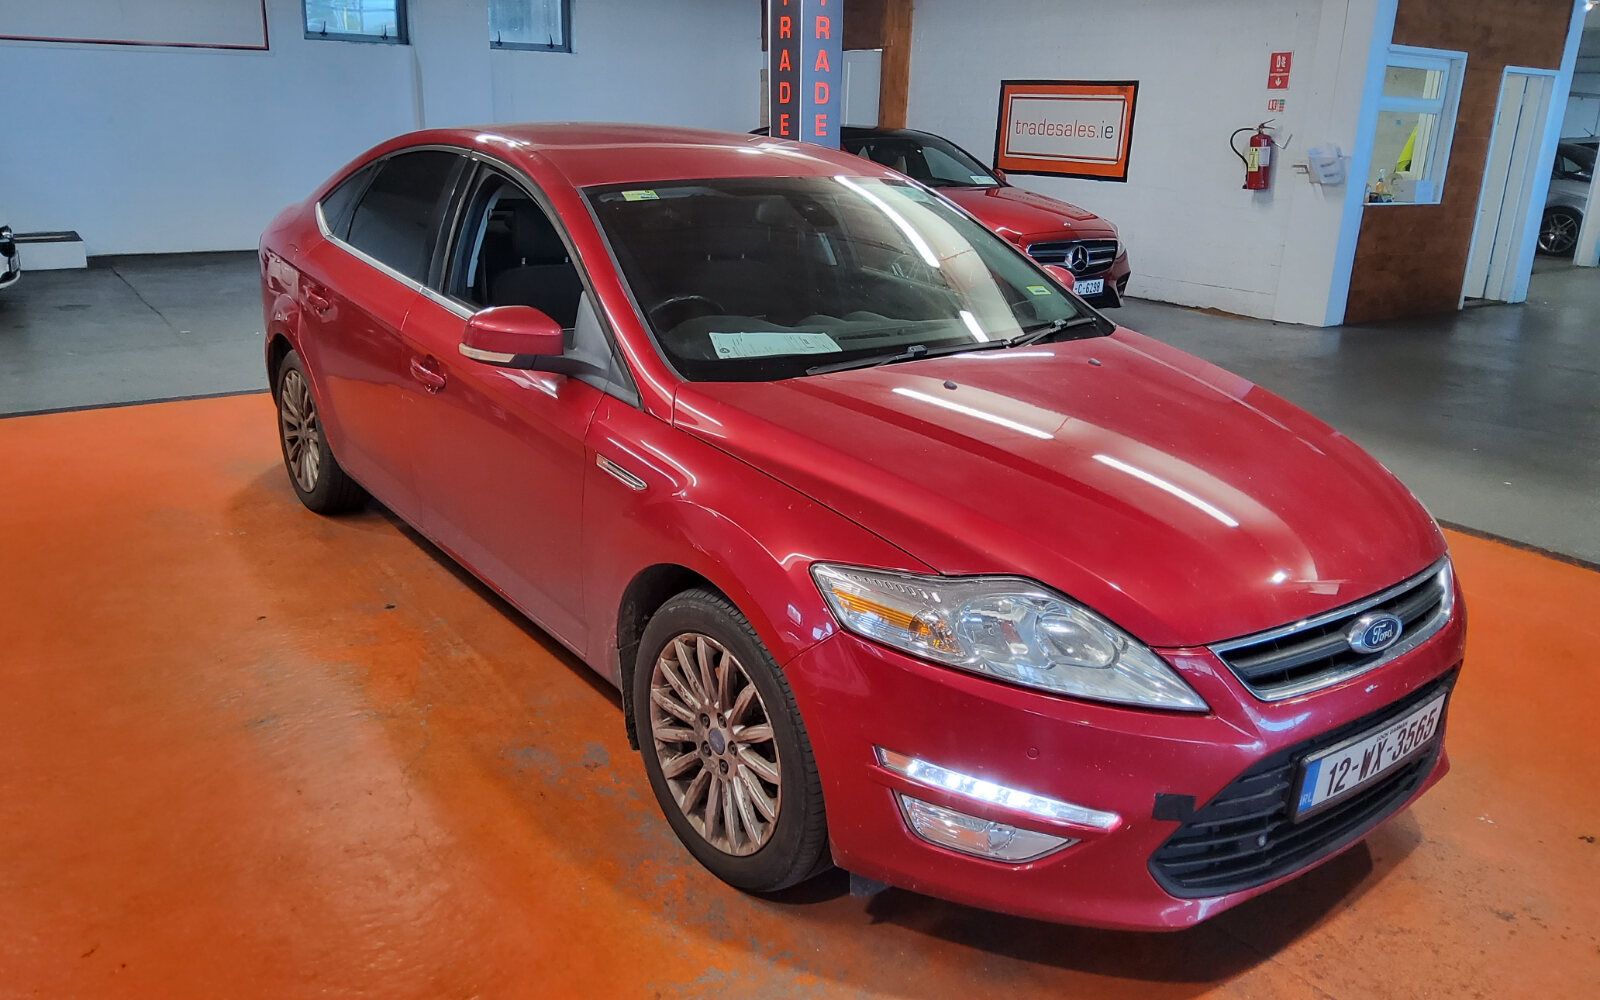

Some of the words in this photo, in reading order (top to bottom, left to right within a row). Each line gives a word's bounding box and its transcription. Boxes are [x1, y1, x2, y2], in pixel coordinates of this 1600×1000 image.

[779, 0, 791, 136] RADE
[814, 0, 830, 136] RADE
[1015, 118, 1114, 139] tradesales.ie
[1371, 623, 1393, 645] Ford
[1326, 707, 1438, 797] 12-WX-3565
